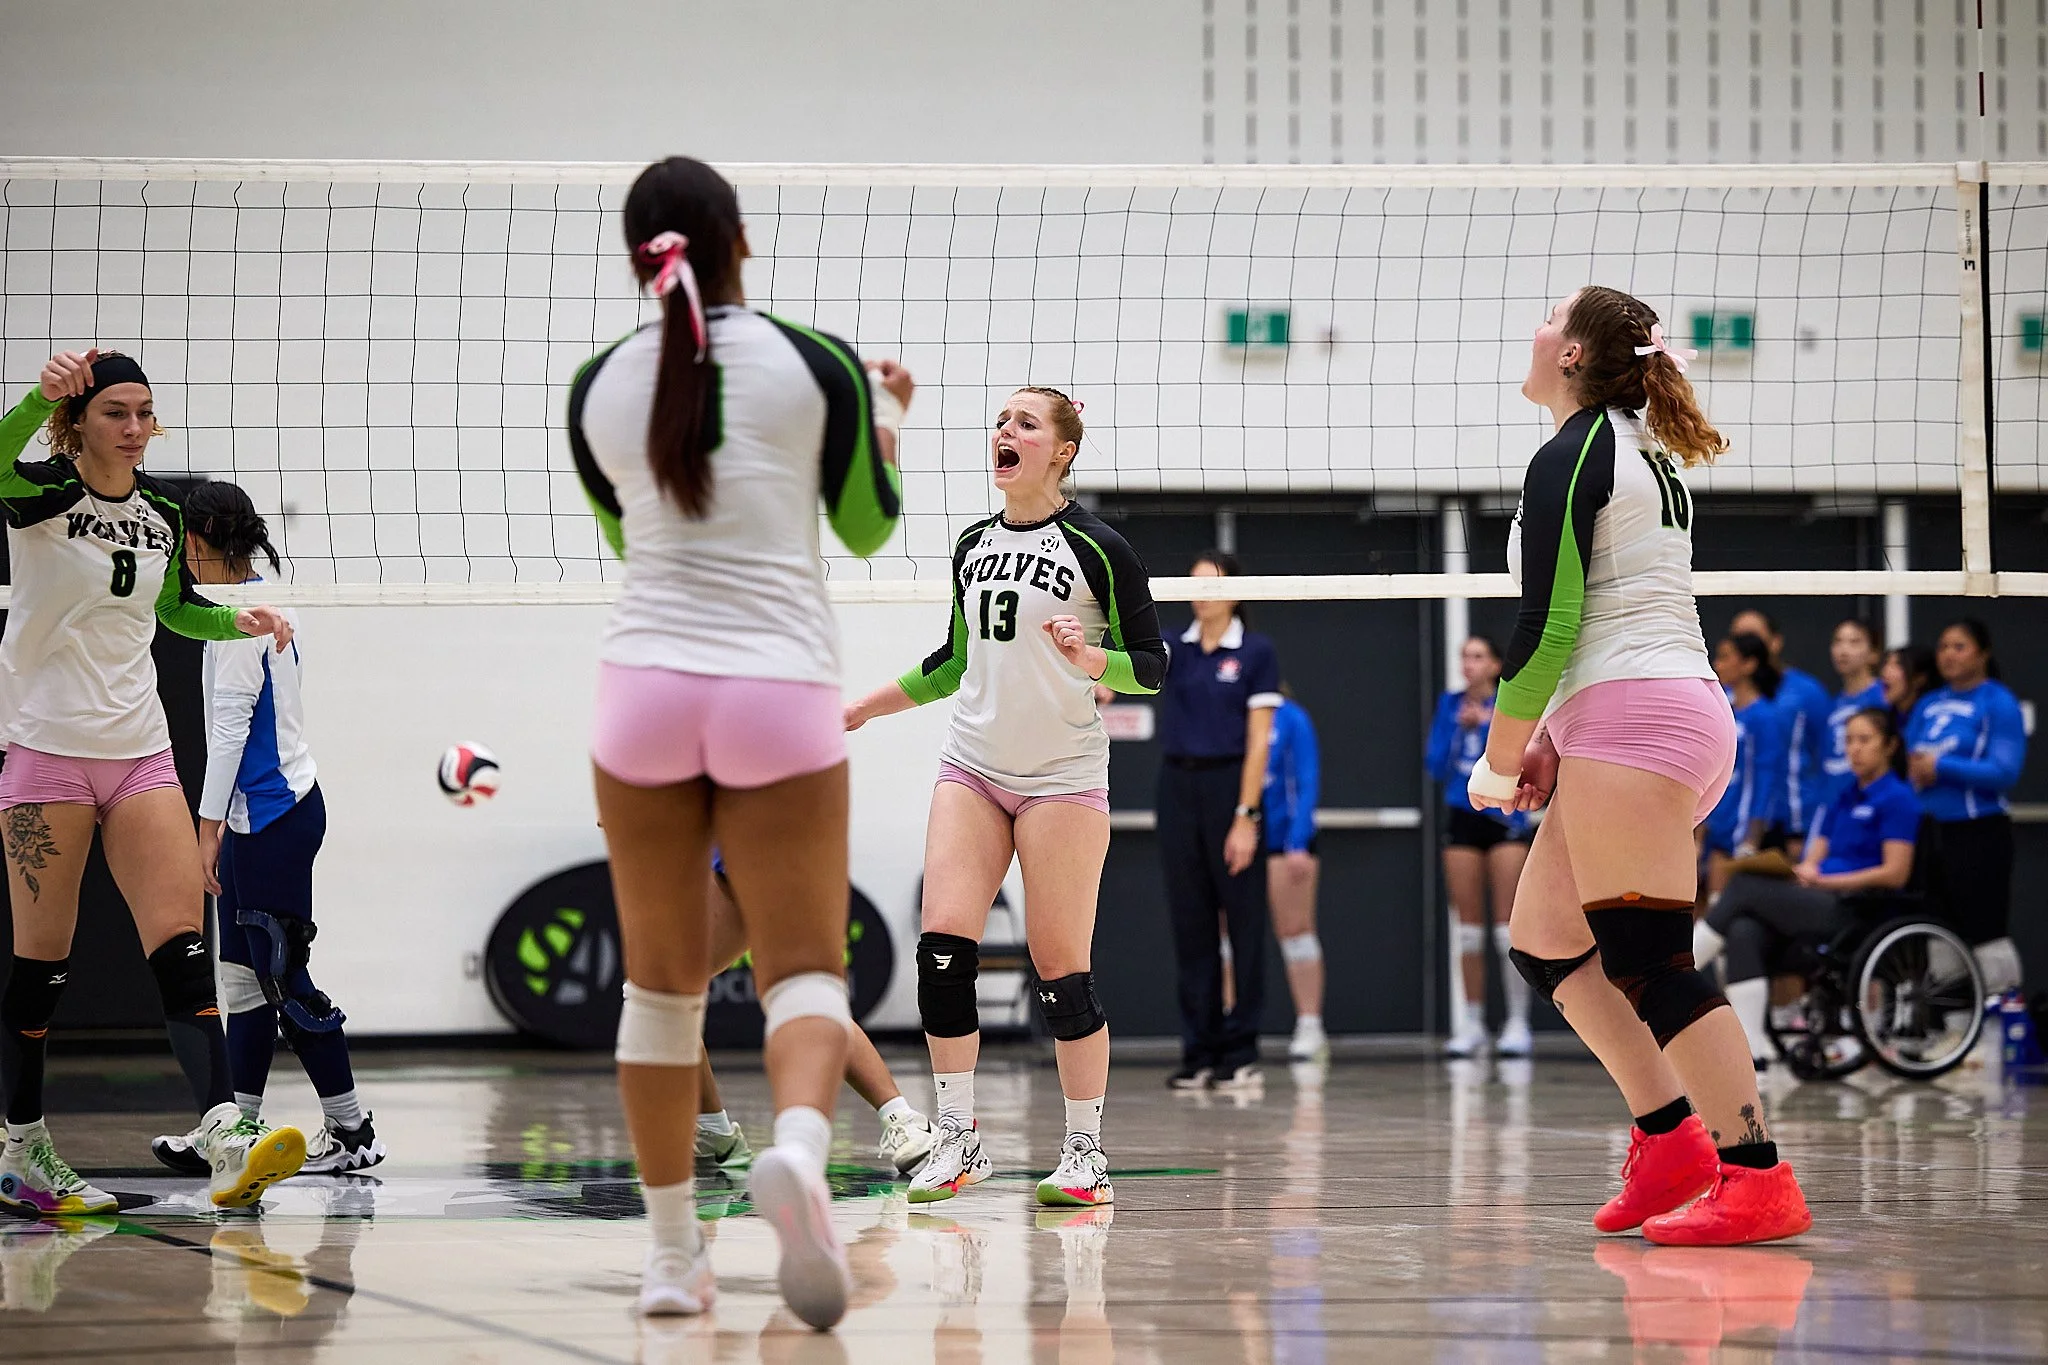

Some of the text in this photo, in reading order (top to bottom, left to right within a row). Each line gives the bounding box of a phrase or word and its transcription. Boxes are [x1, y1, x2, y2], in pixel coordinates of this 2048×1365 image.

[111, 549, 136, 598] 8
[962, 552, 1075, 602] WOLVES
[979, 589, 1019, 642] 13
